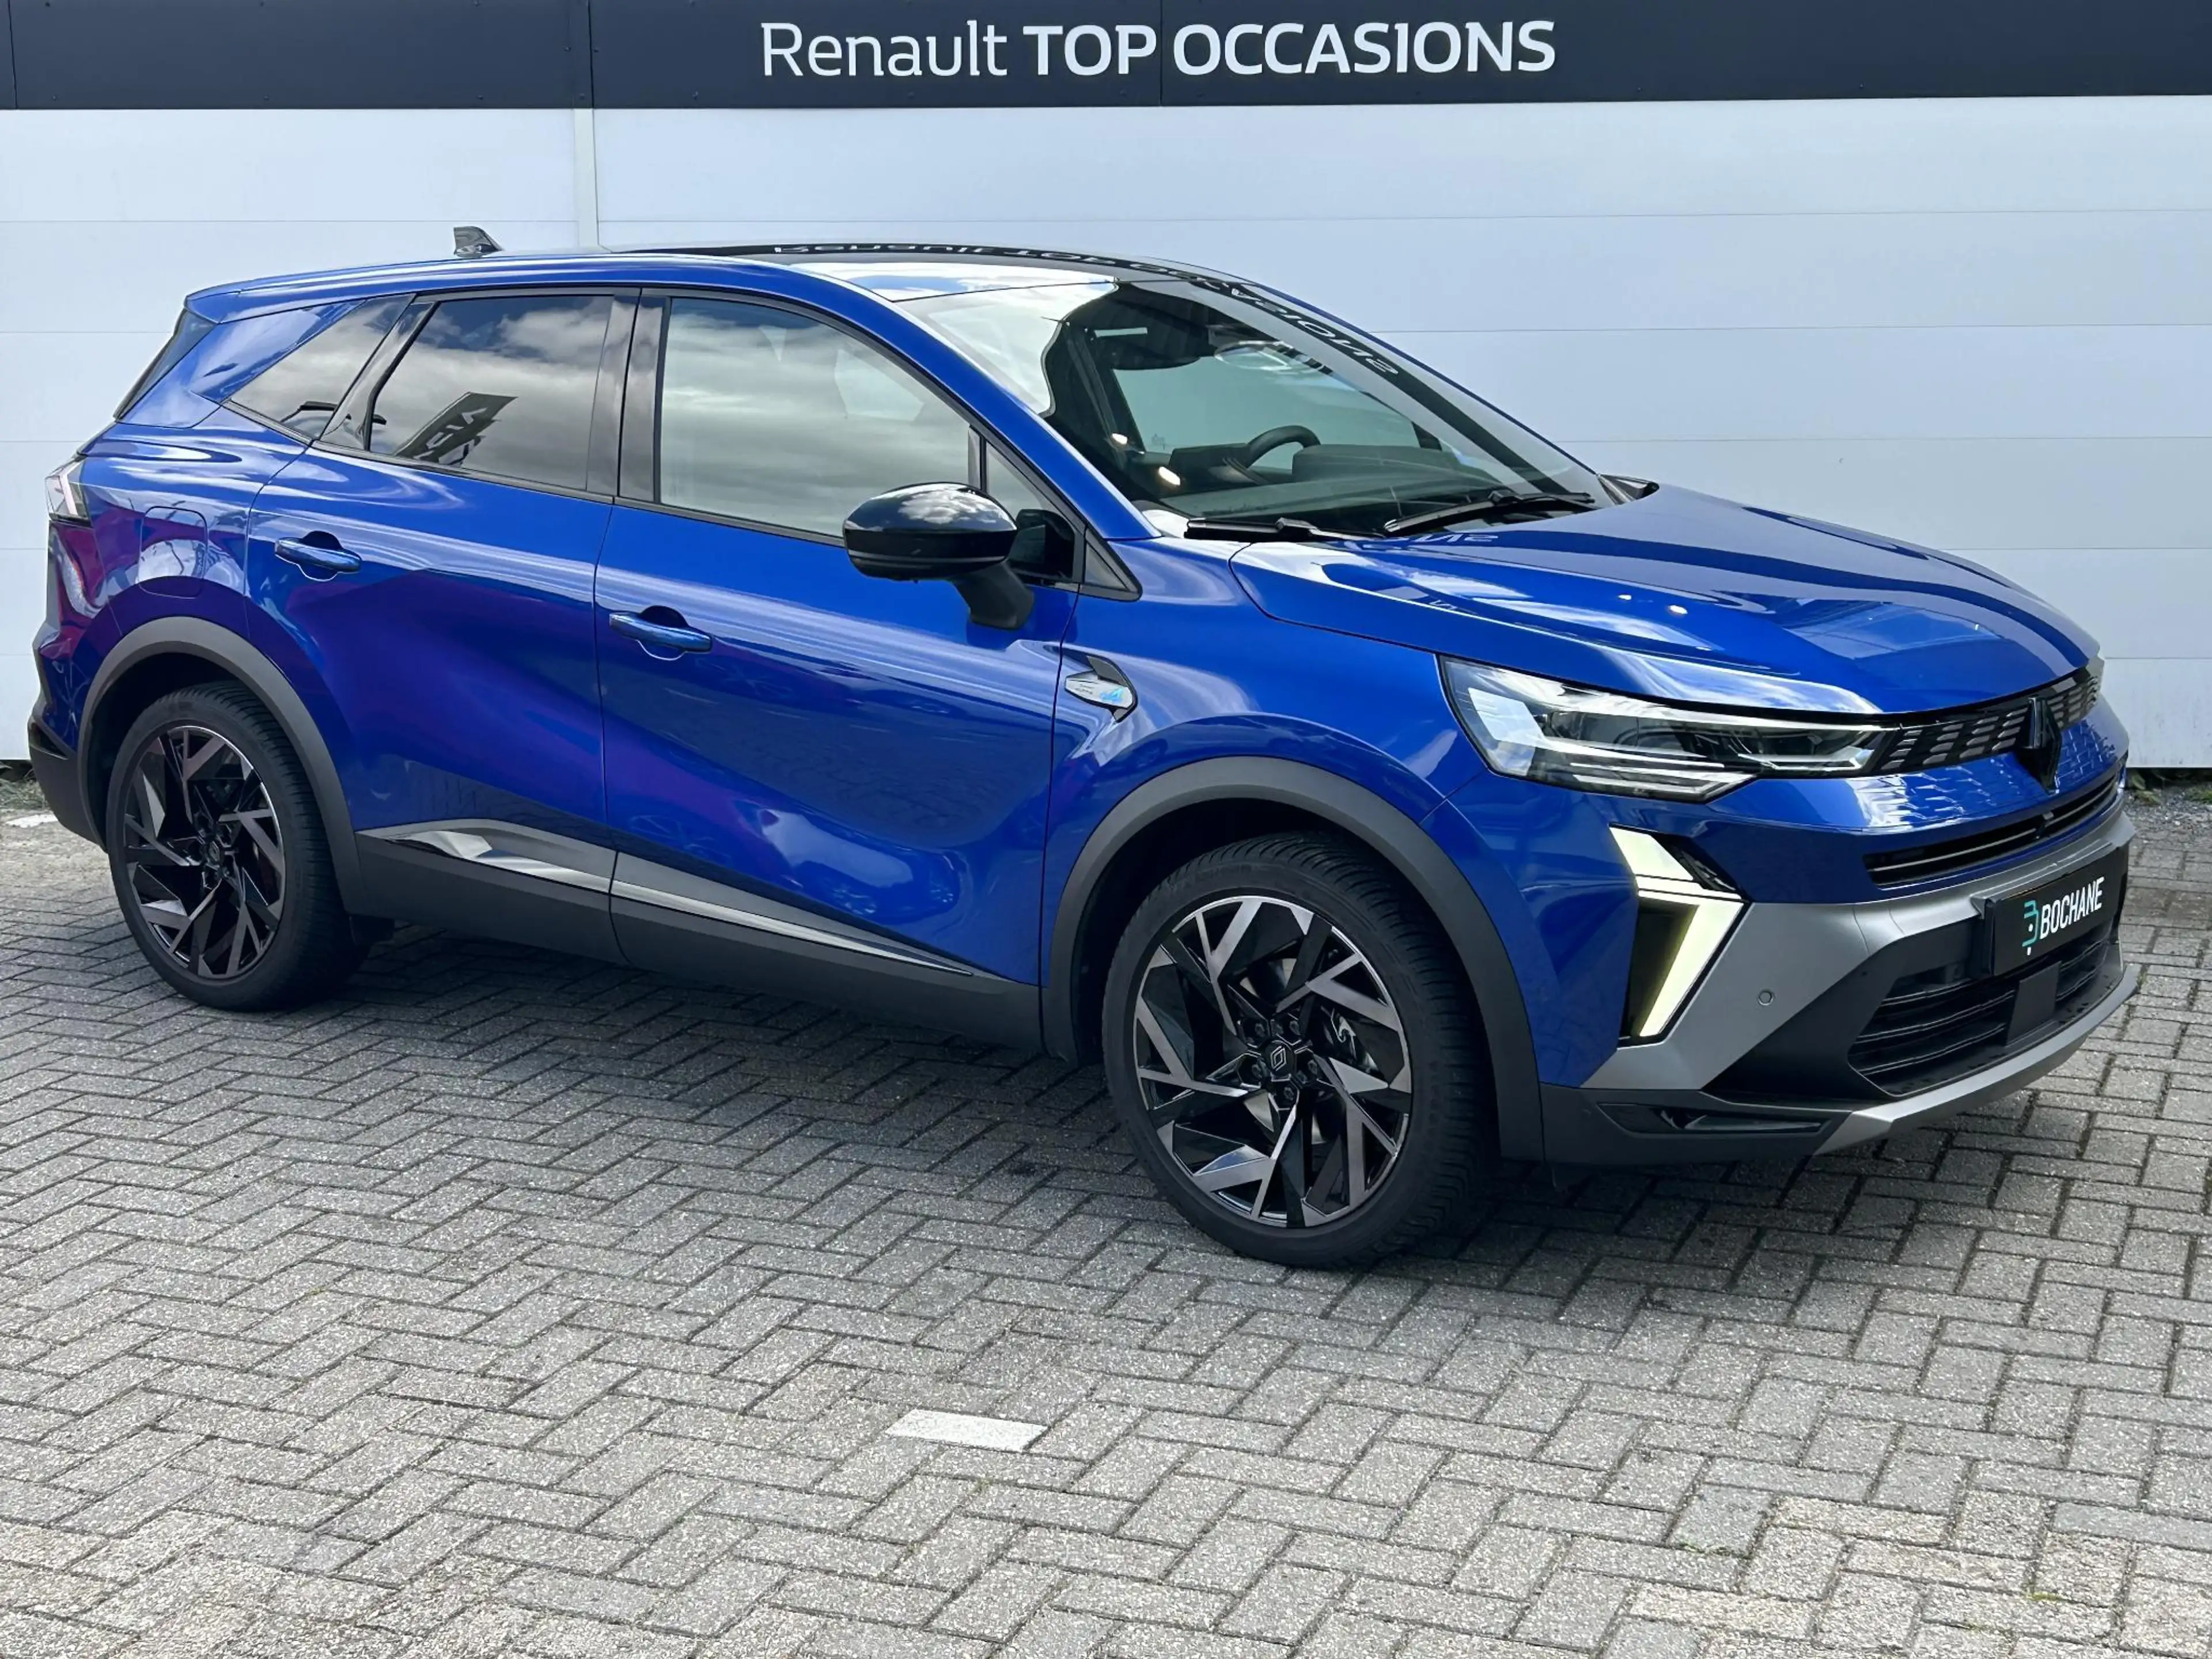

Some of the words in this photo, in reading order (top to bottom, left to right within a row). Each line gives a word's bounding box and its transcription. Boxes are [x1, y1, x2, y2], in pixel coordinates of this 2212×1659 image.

[761, 20, 1007, 77] Renault
[1023, 25, 1157, 76] TOP
[1173, 20, 1555, 75] OCCASIONS
[2040, 877, 2105, 940] BOCHANE
